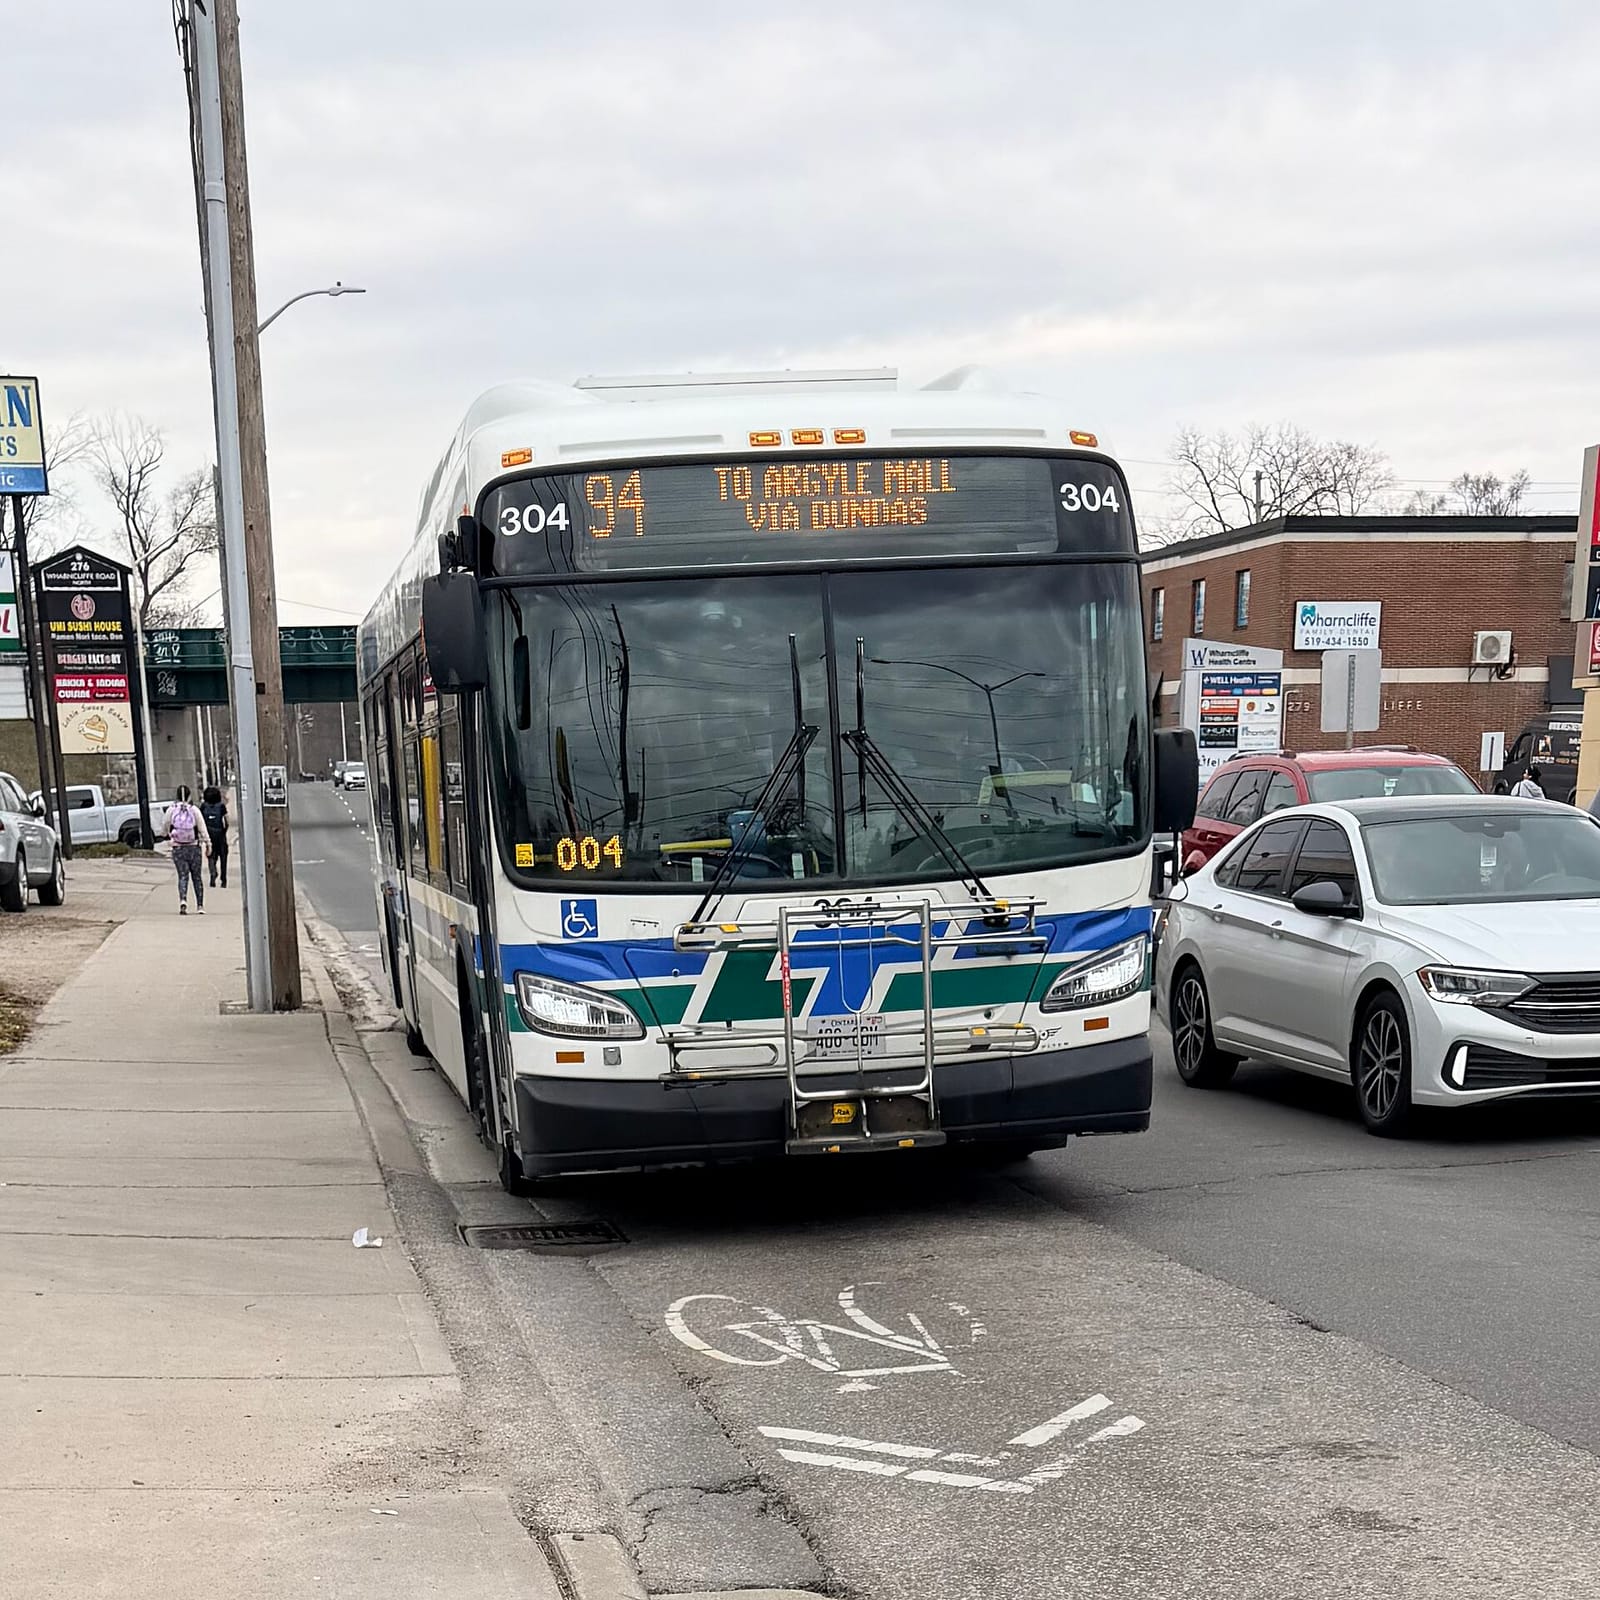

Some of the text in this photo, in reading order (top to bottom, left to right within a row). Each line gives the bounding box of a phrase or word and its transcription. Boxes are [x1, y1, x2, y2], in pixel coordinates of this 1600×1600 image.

[713, 459, 958, 501] TO ARGYLE MALL
[585, 469, 645, 538] 94
[1059, 483, 1120, 513] 304
[500, 502, 570, 536] 304
[744, 496, 930, 532] VIA DUNDAS
[70, 561, 90, 572] 276
[49, 621, 122, 632] UMI SUSHI HOUSE
[1300, 611, 1377, 627] Wharncliffe
[1304, 636, 1369, 646] 519-434-1550
[1209, 649, 1249, 657] Wharncliffe
[1209, 658, 1257, 666] Health Centre
[557, 835, 624, 871] 004
[831, 1019, 862, 1027] ONTAR
